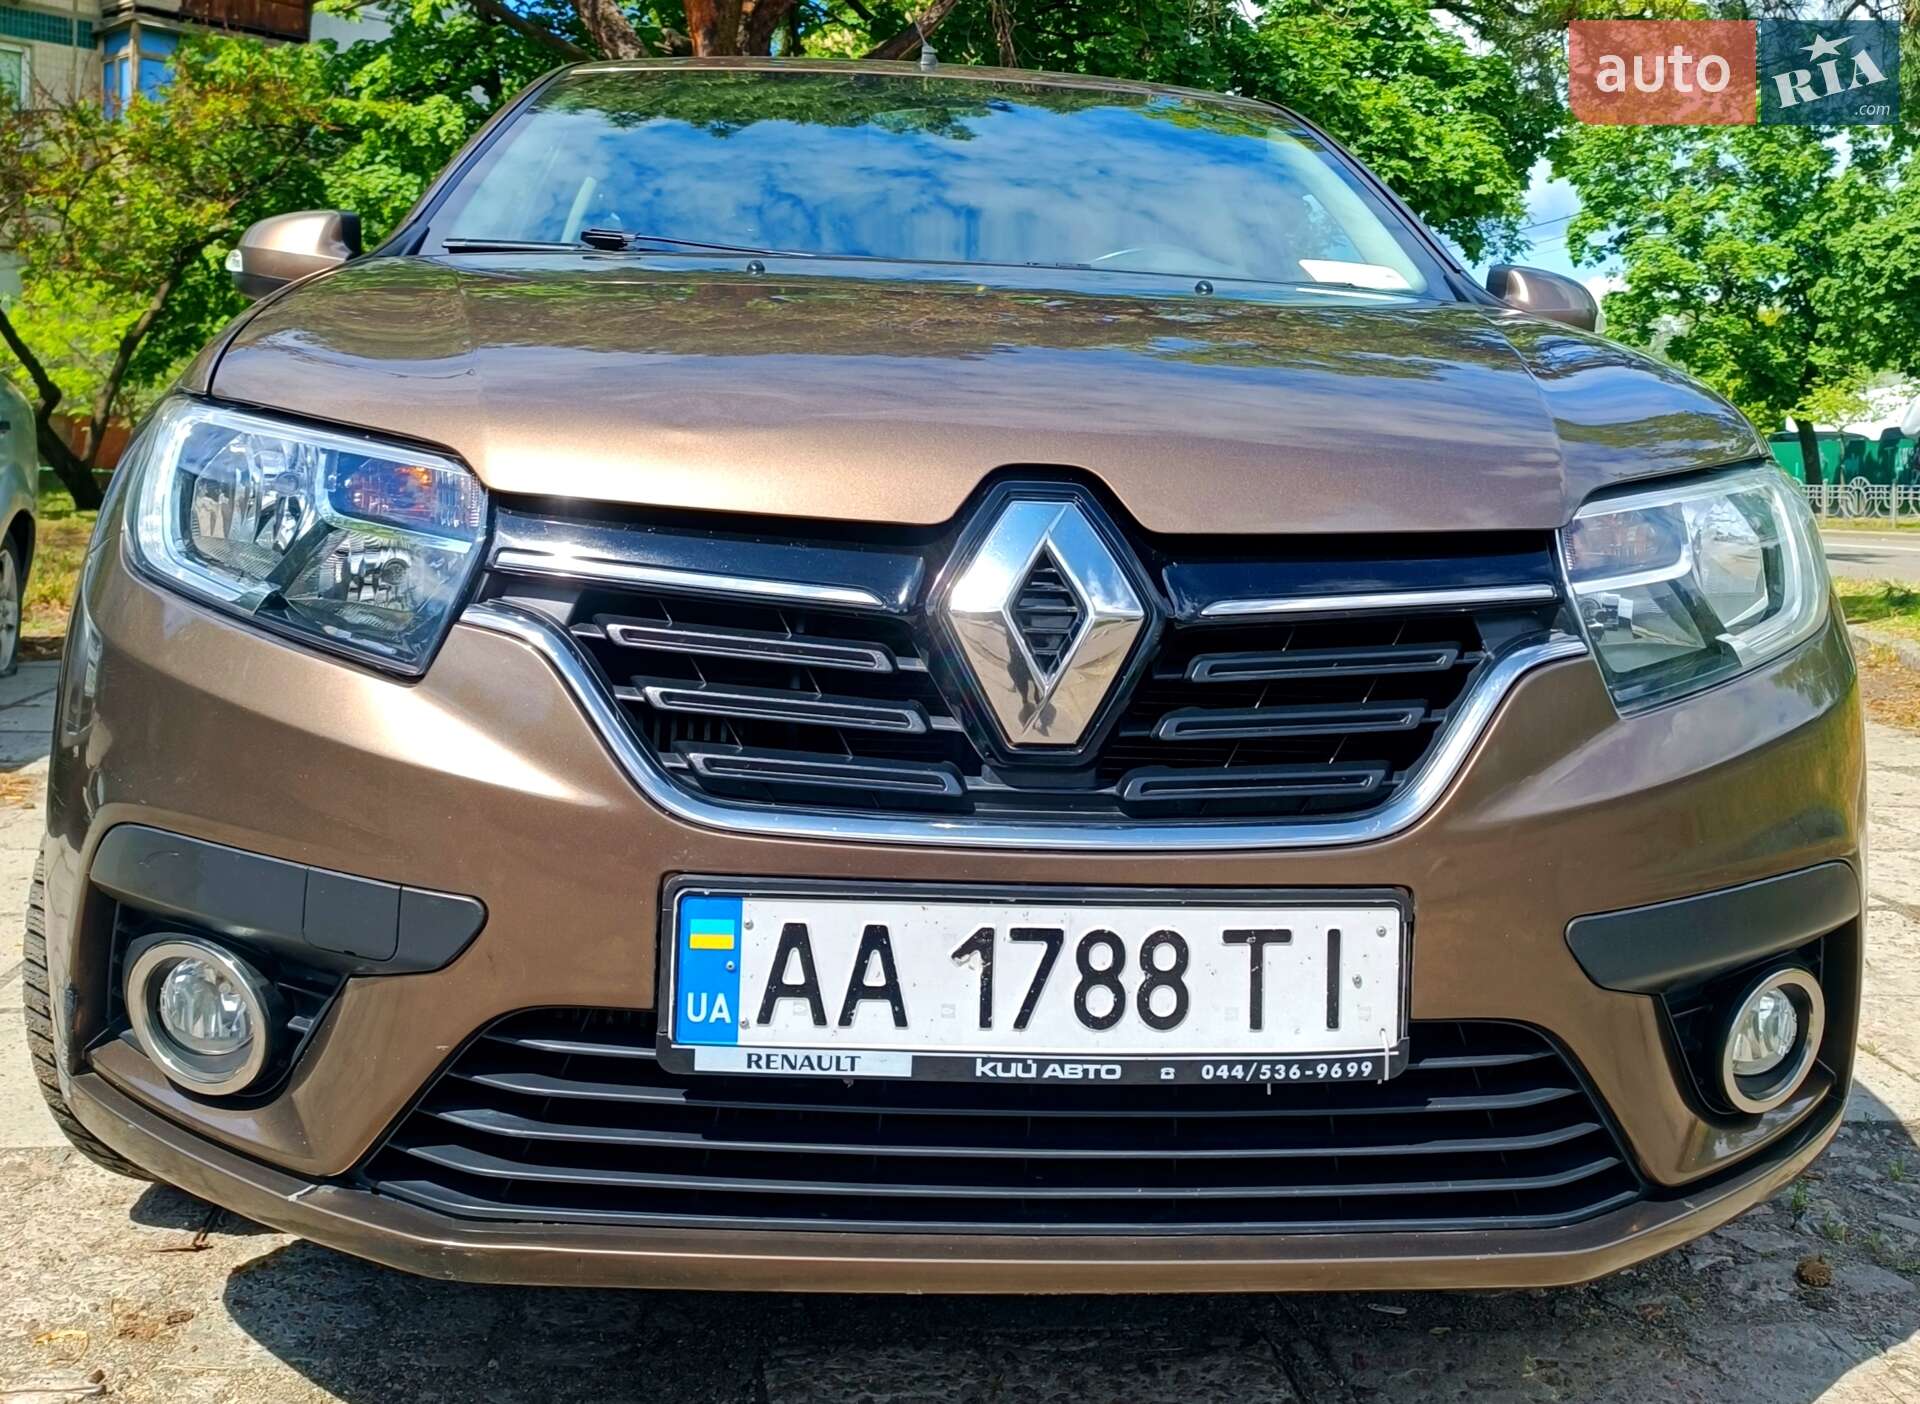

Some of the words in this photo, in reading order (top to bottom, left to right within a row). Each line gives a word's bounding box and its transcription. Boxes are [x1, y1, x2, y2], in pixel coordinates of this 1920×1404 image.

[756, 922, 909, 1028] AA
[951, 927, 1190, 1031] 1788
[1222, 928, 1341, 1030] TI
[687, 992, 732, 1024] UA
[746, 1052, 861, 1072] RENAULT
[1201, 1061, 1374, 1082] 044/536-9699
